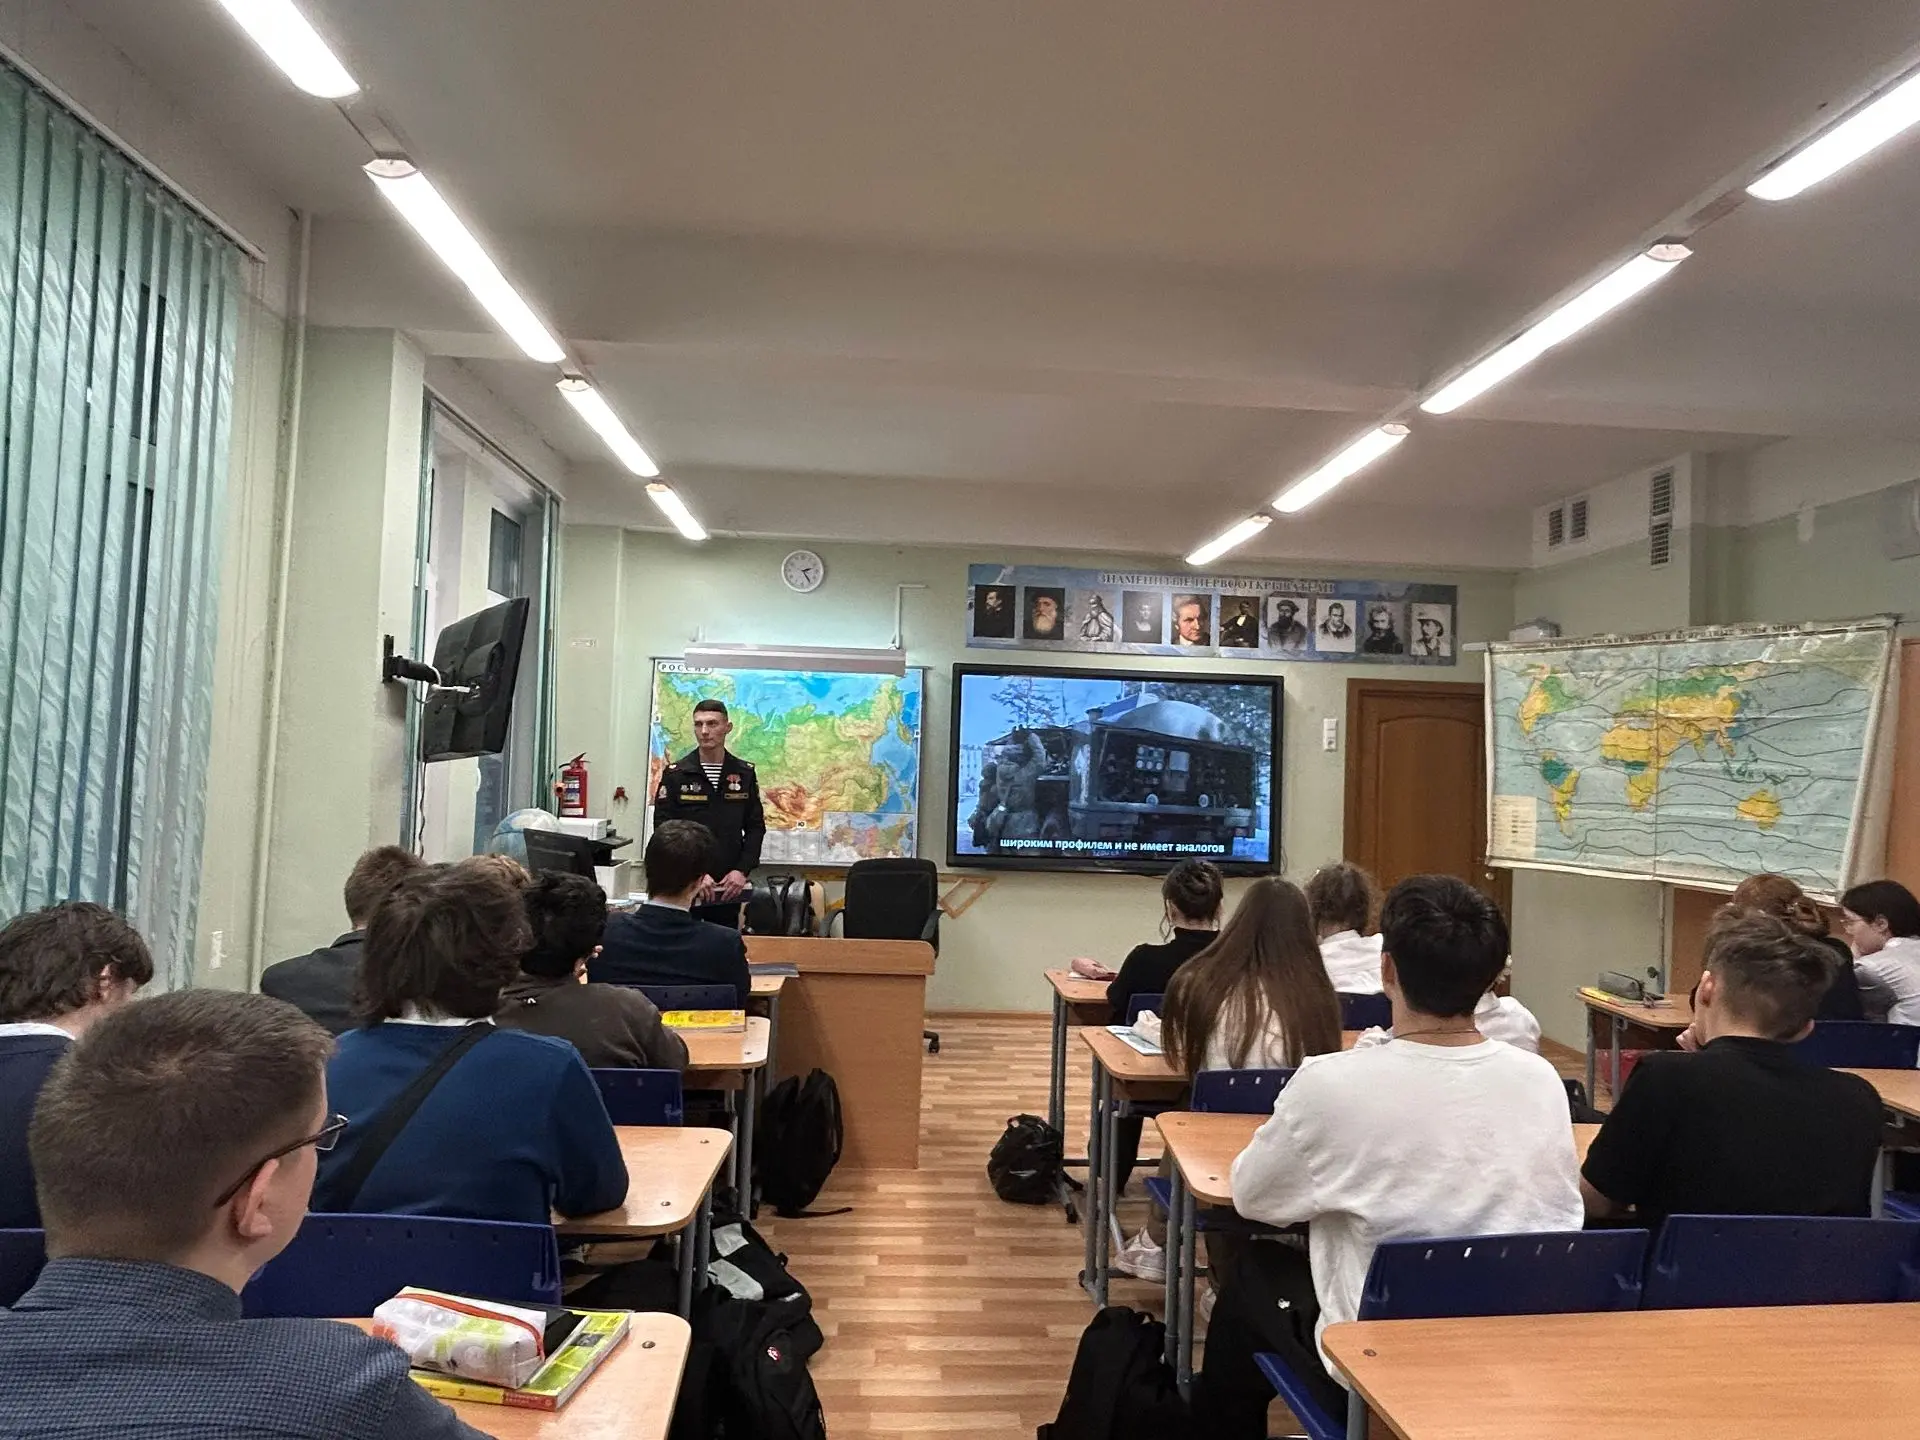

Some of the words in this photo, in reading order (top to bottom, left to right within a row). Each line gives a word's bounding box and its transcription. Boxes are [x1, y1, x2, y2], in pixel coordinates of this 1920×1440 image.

[1000, 838, 1052, 849] широким
[1055, 839, 1112, 851] профилем
[1114, 842, 1122, 850] и
[1124, 842, 1138, 850] не
[1140, 843, 1173, 852] имеет
[1175, 844, 1225, 853] аналогов
